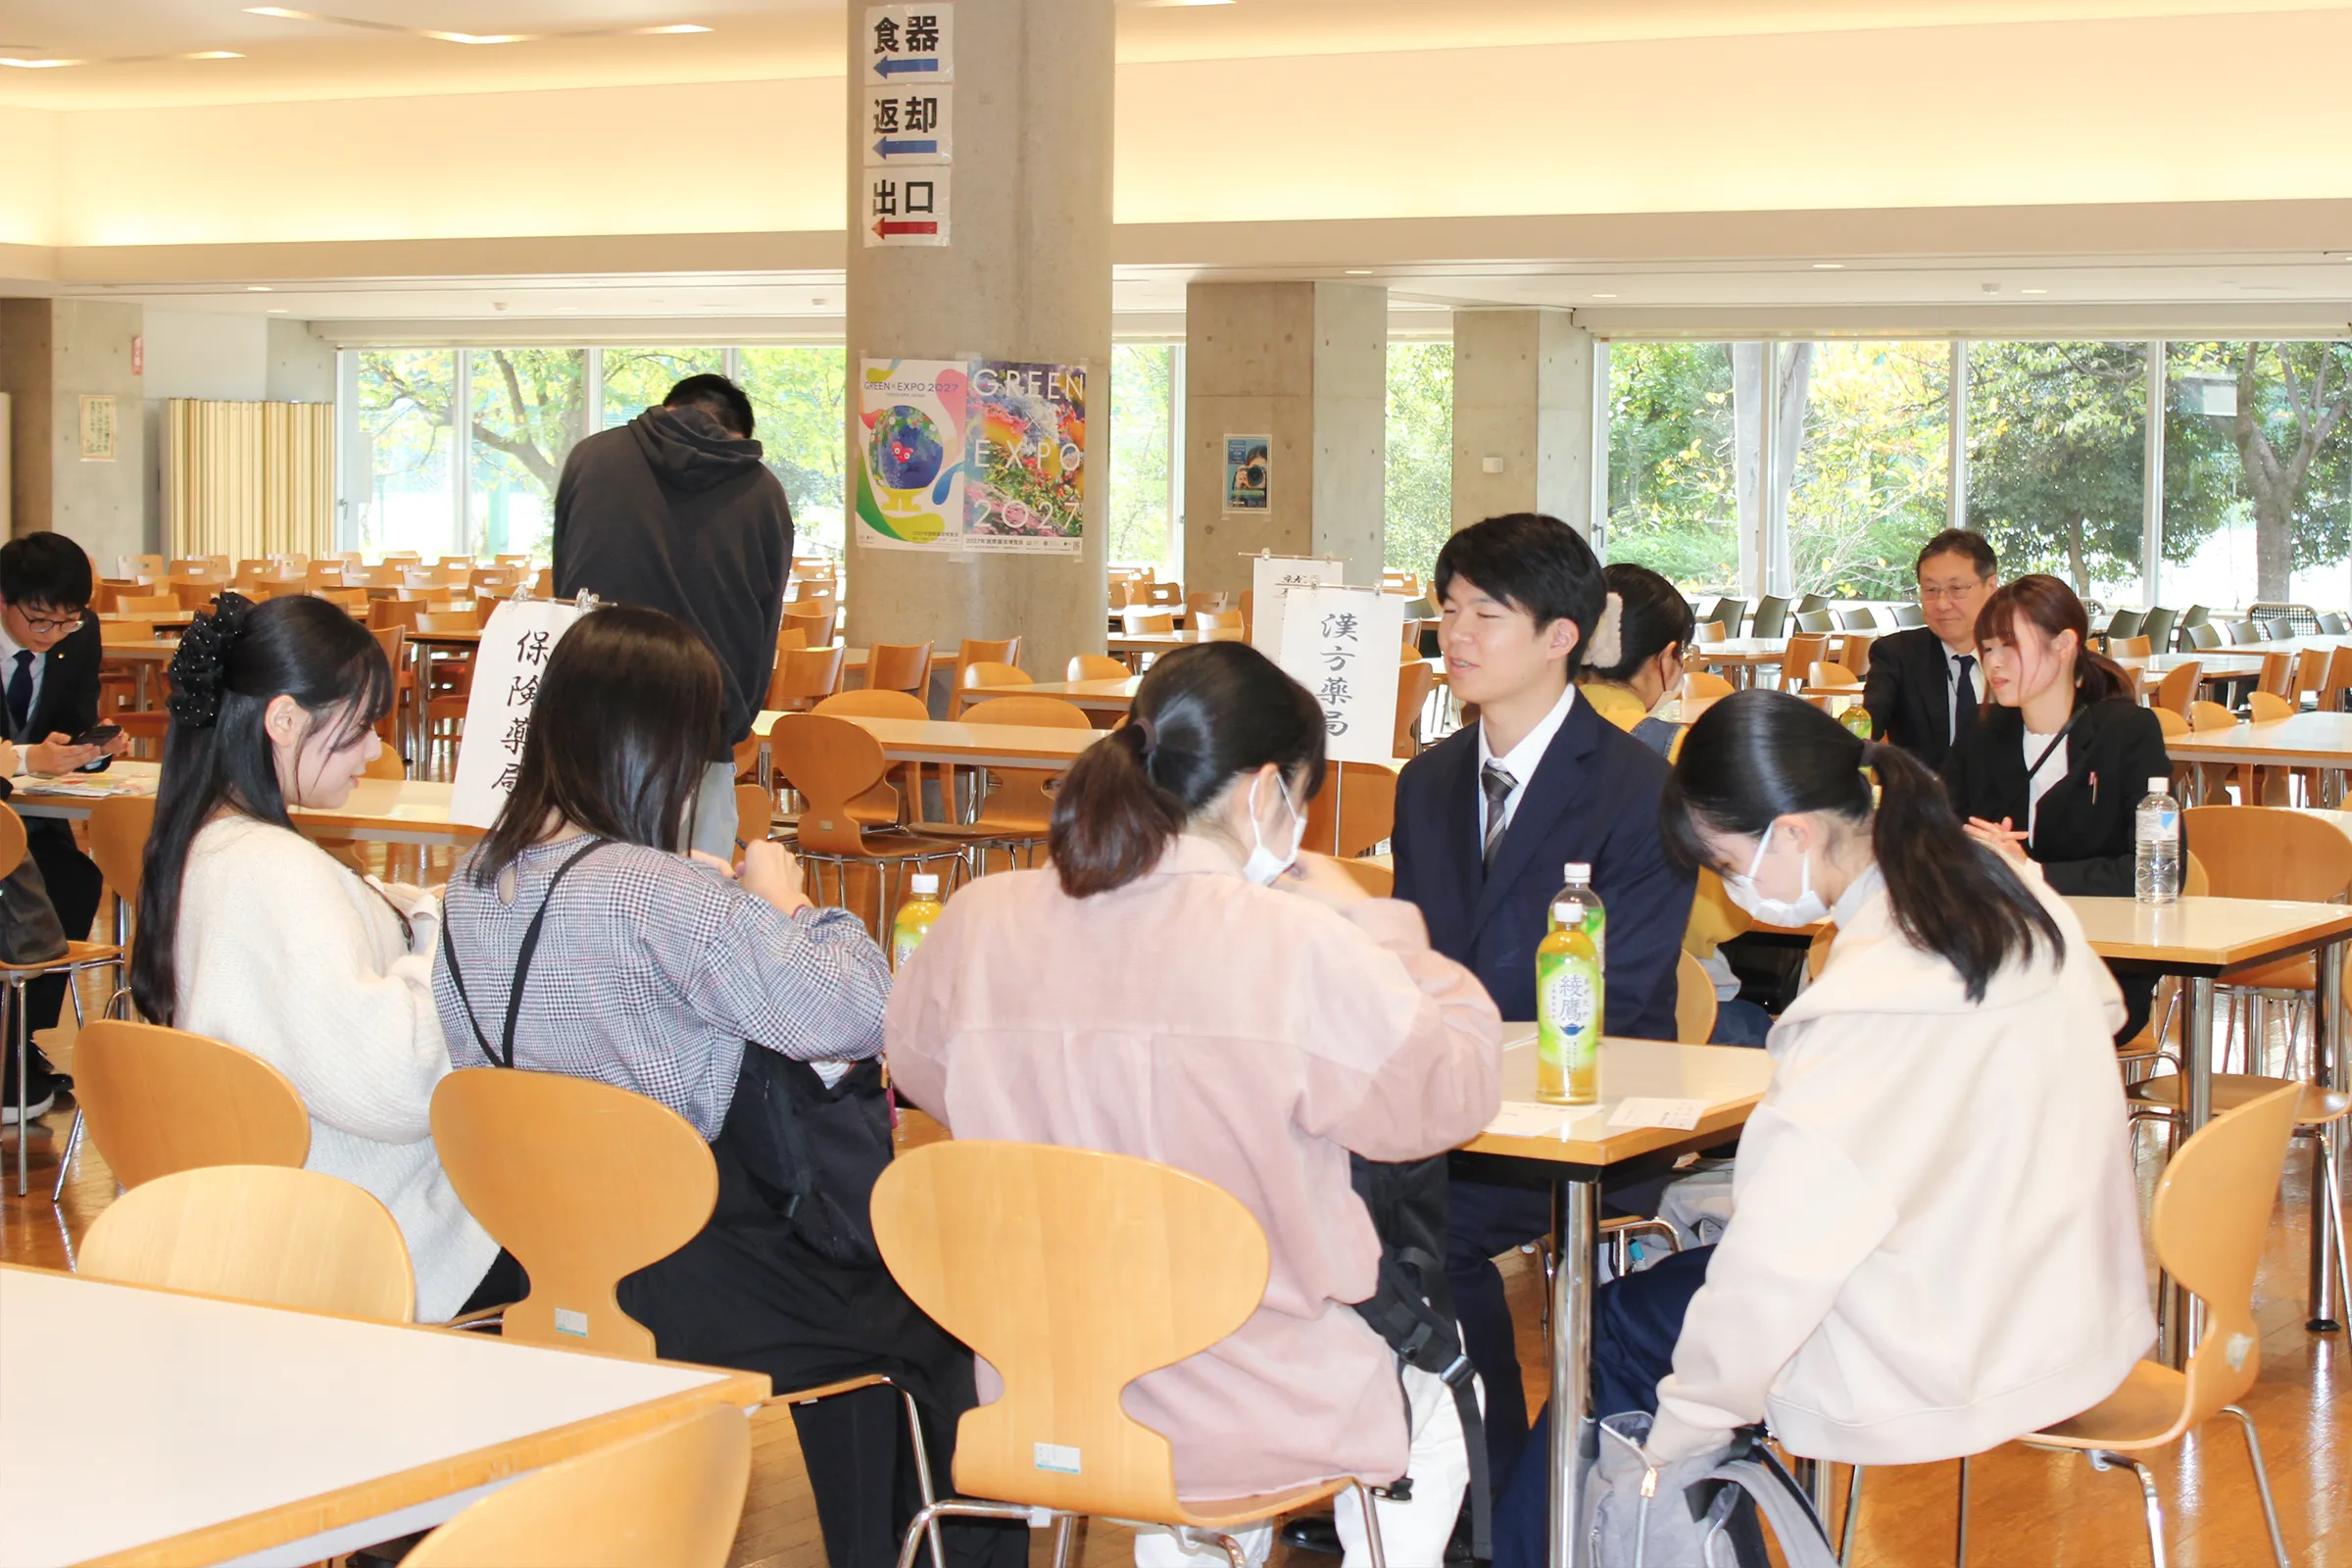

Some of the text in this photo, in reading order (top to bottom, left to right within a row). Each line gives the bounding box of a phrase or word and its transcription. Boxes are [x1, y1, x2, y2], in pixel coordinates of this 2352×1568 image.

[874, 16, 939, 54] 食器
[873, 96, 938, 134] 返却
[872, 178, 934, 216] 出口
[927, 383, 959, 393] 2027
[972, 368, 1083, 400] GREEN
[974, 439, 1080, 471] EXPO
[973, 499, 1080, 529] 2027
[1315, 612, 1359, 737] 漢方薬局
[1559, 974, 1583, 1021] 綾鷹
